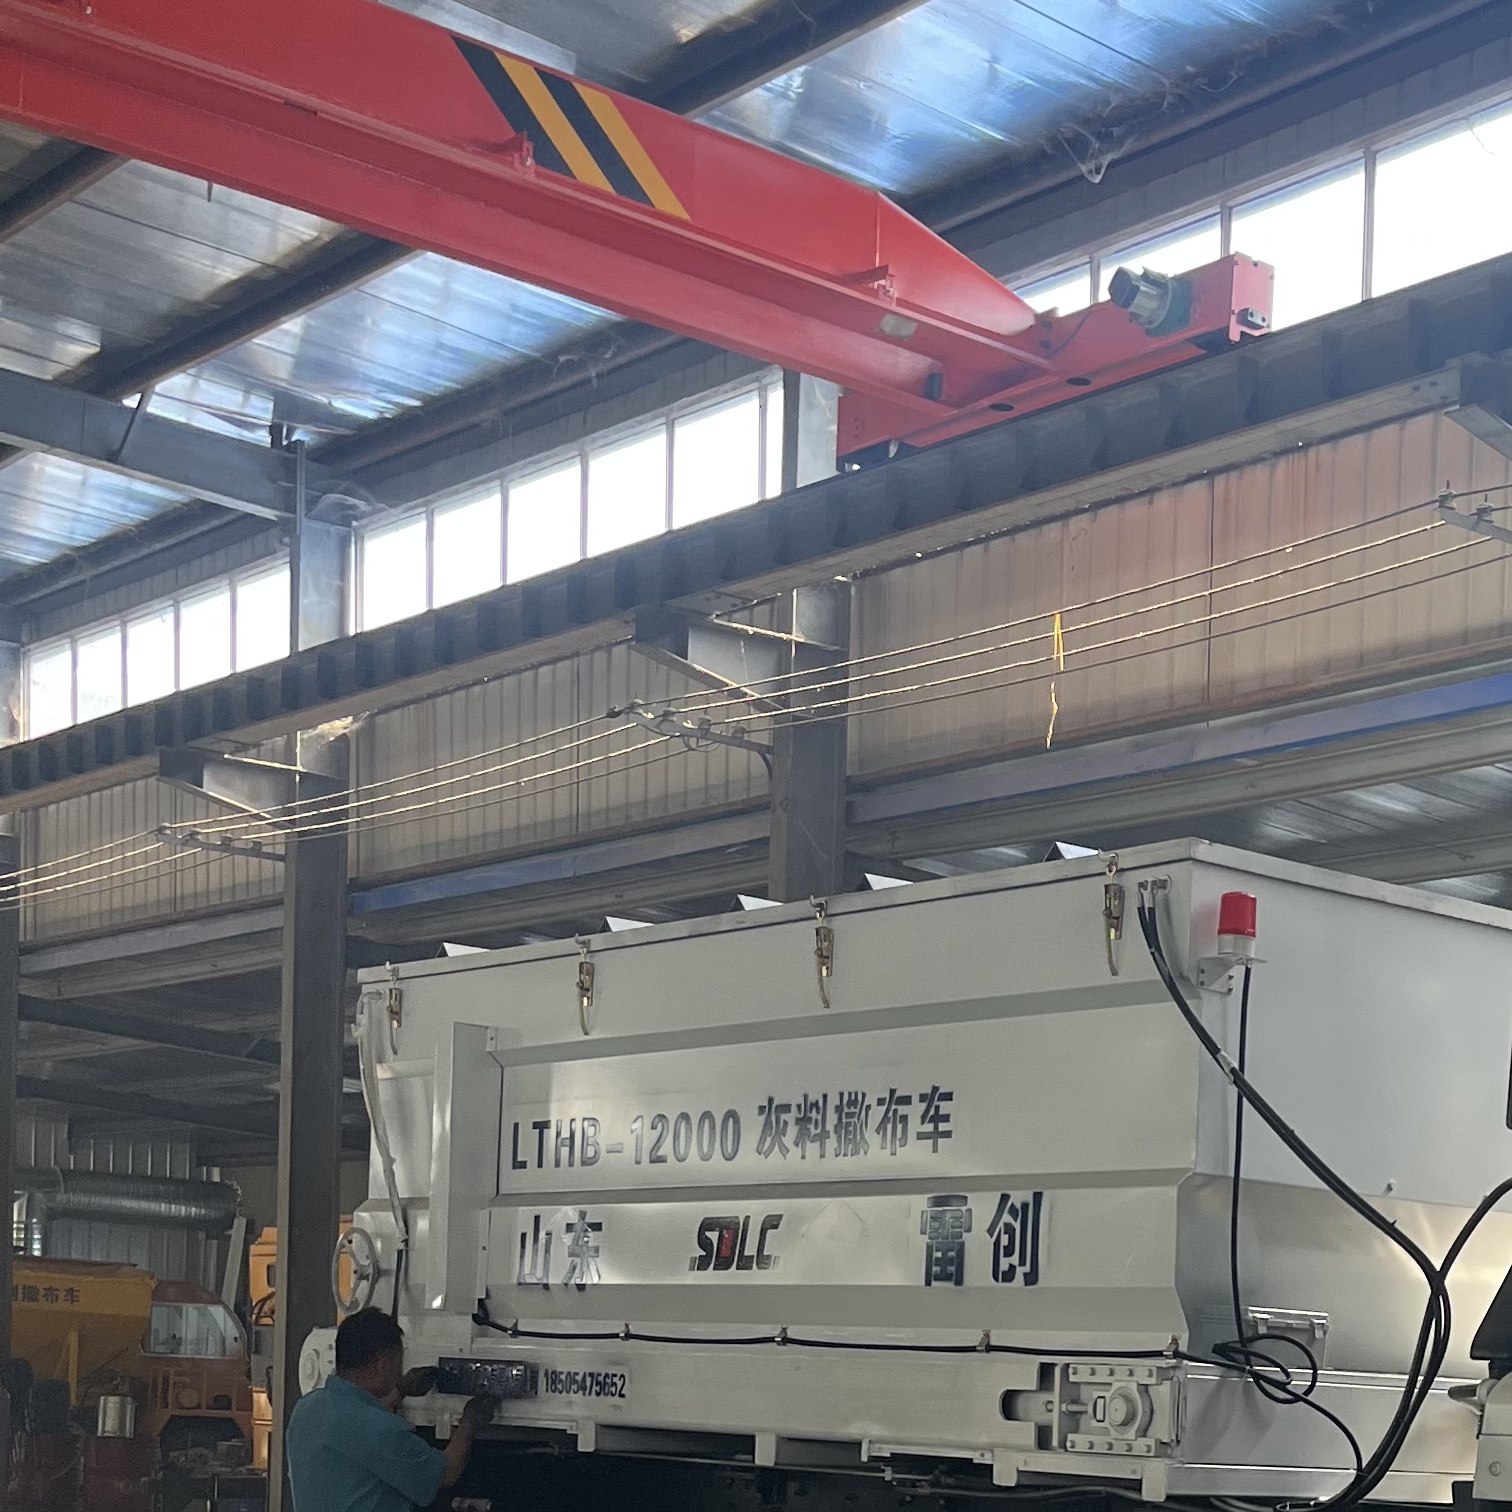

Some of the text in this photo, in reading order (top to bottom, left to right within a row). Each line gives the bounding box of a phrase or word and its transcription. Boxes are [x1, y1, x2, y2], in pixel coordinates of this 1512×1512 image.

[511, 1084, 955, 1171] LTHB-12000 灰料撒布车
[515, 1190, 1044, 1290] 山东 SDLC 雷创
[543, 1368, 627, 1398] 18505475652
